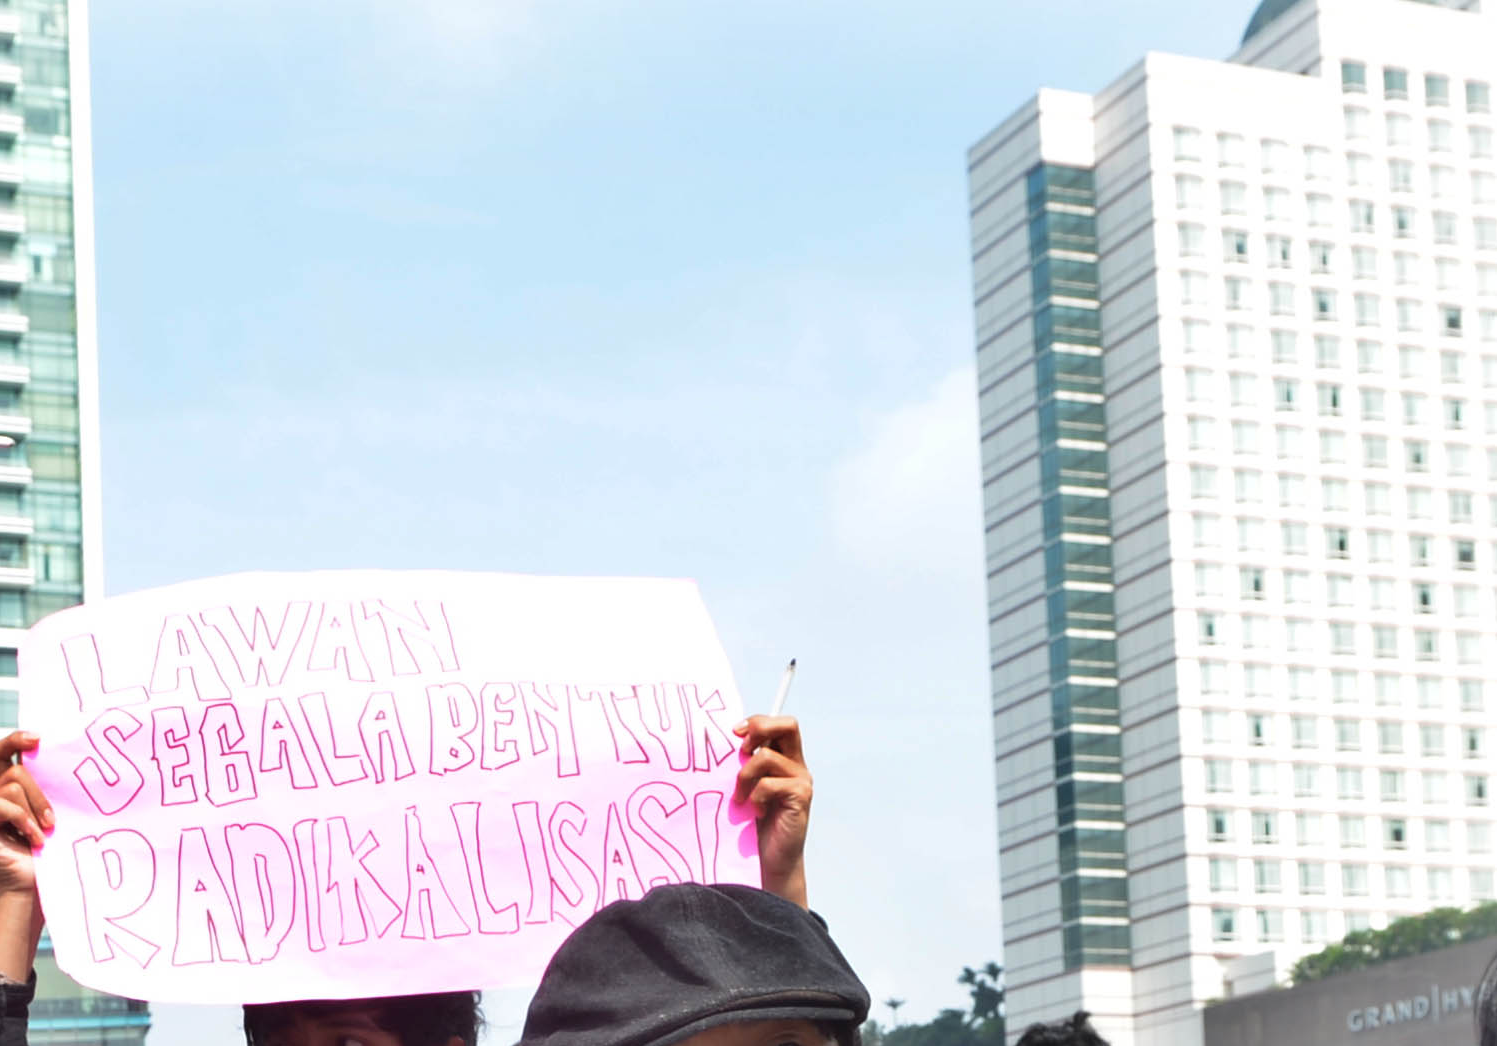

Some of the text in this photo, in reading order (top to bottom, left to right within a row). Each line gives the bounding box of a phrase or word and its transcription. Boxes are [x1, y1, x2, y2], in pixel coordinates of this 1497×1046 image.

[60, 598, 462, 713] LAWAN
[73, 681, 736, 816] SEGALA BENTUK
[71, 781, 724, 970] RADIKALISASI
